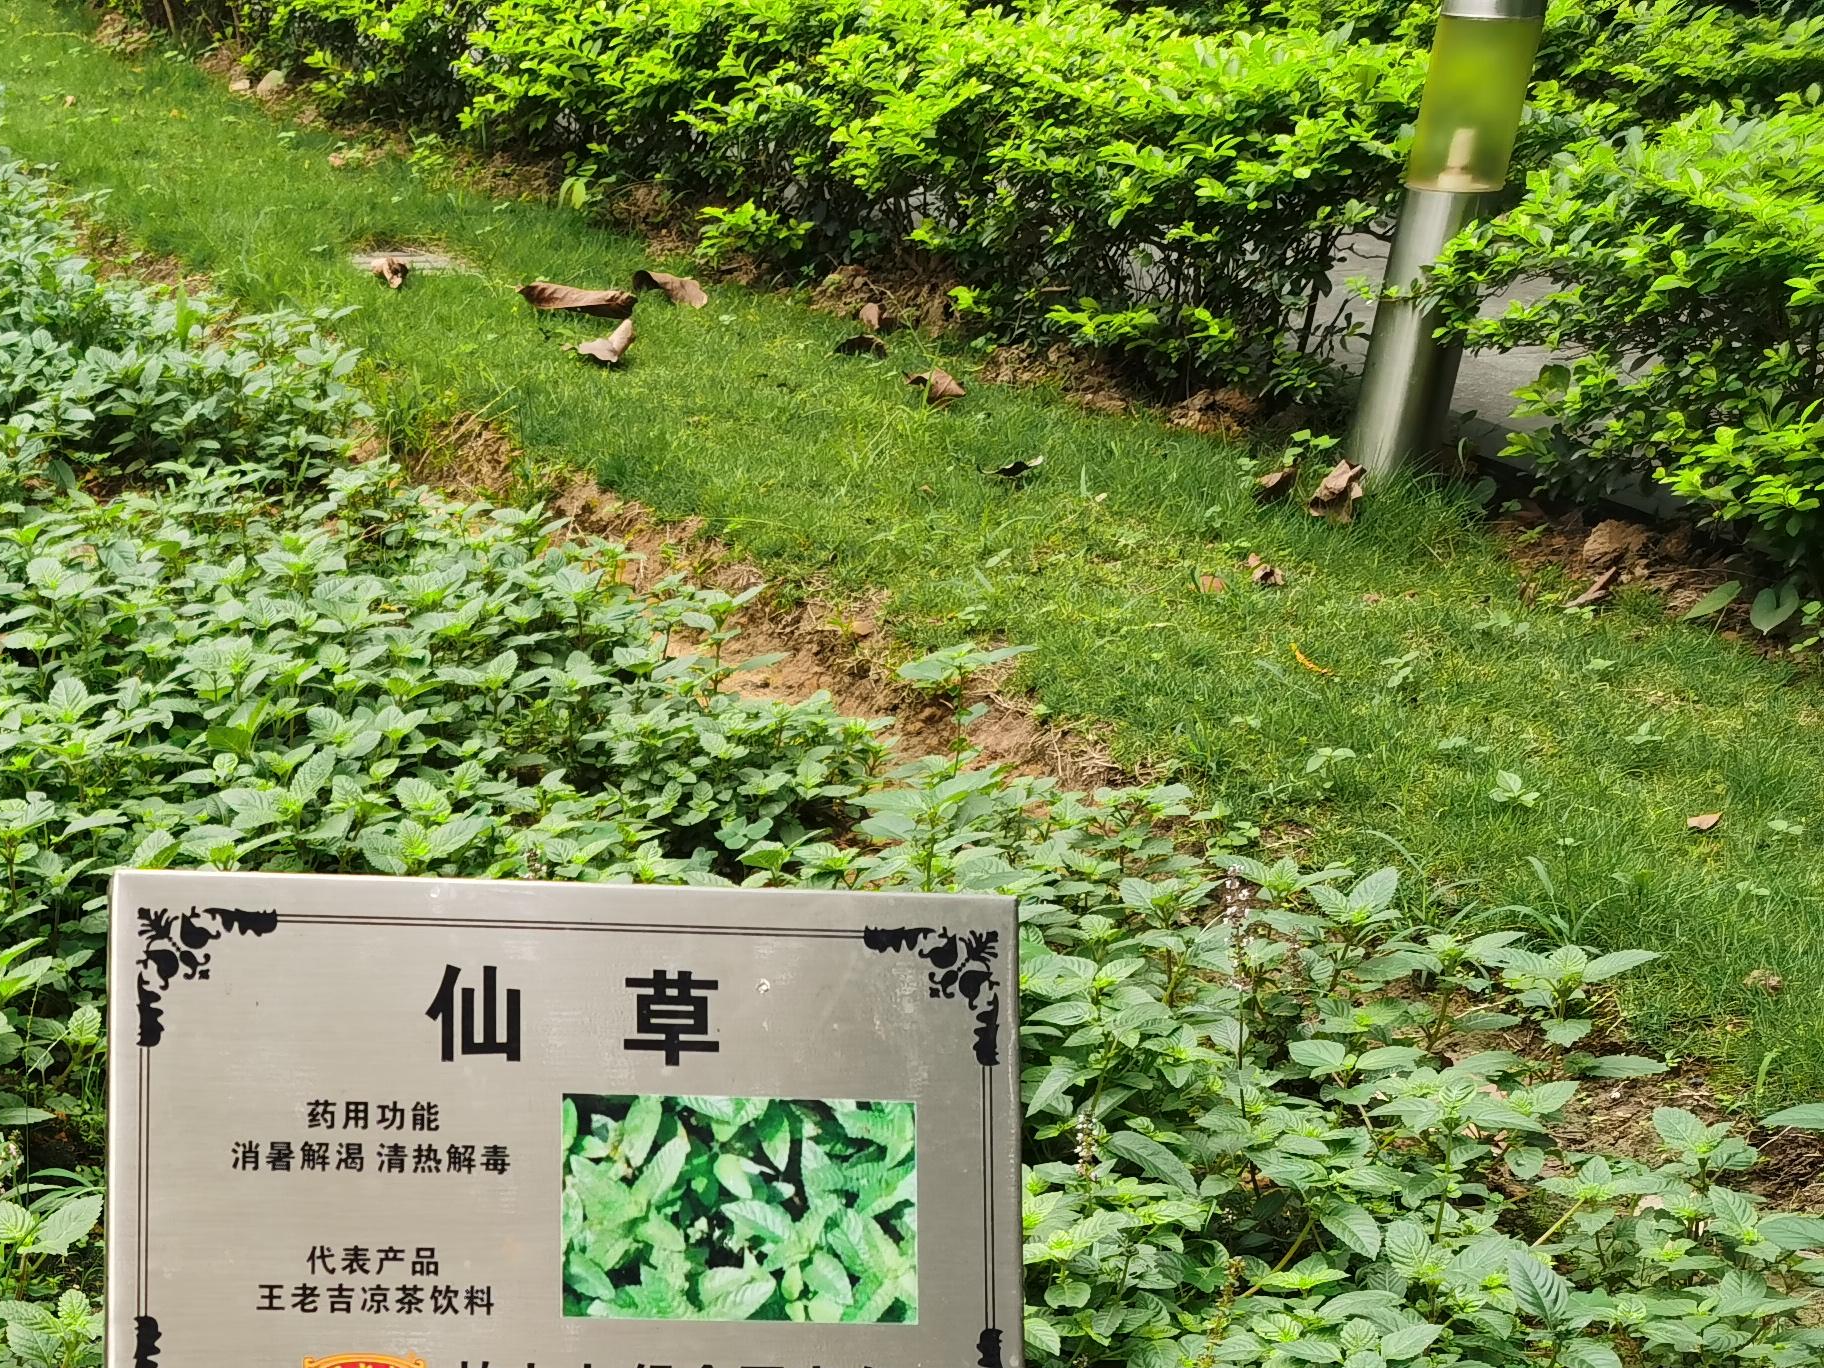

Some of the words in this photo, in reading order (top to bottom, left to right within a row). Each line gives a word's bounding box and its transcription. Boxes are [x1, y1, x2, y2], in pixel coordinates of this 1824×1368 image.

[306, 1099, 440, 1132] 药用功能
[306, 1244, 440, 1277] 代表产品
[256, 1282, 495, 1316] 王老吉凉茶饮料
